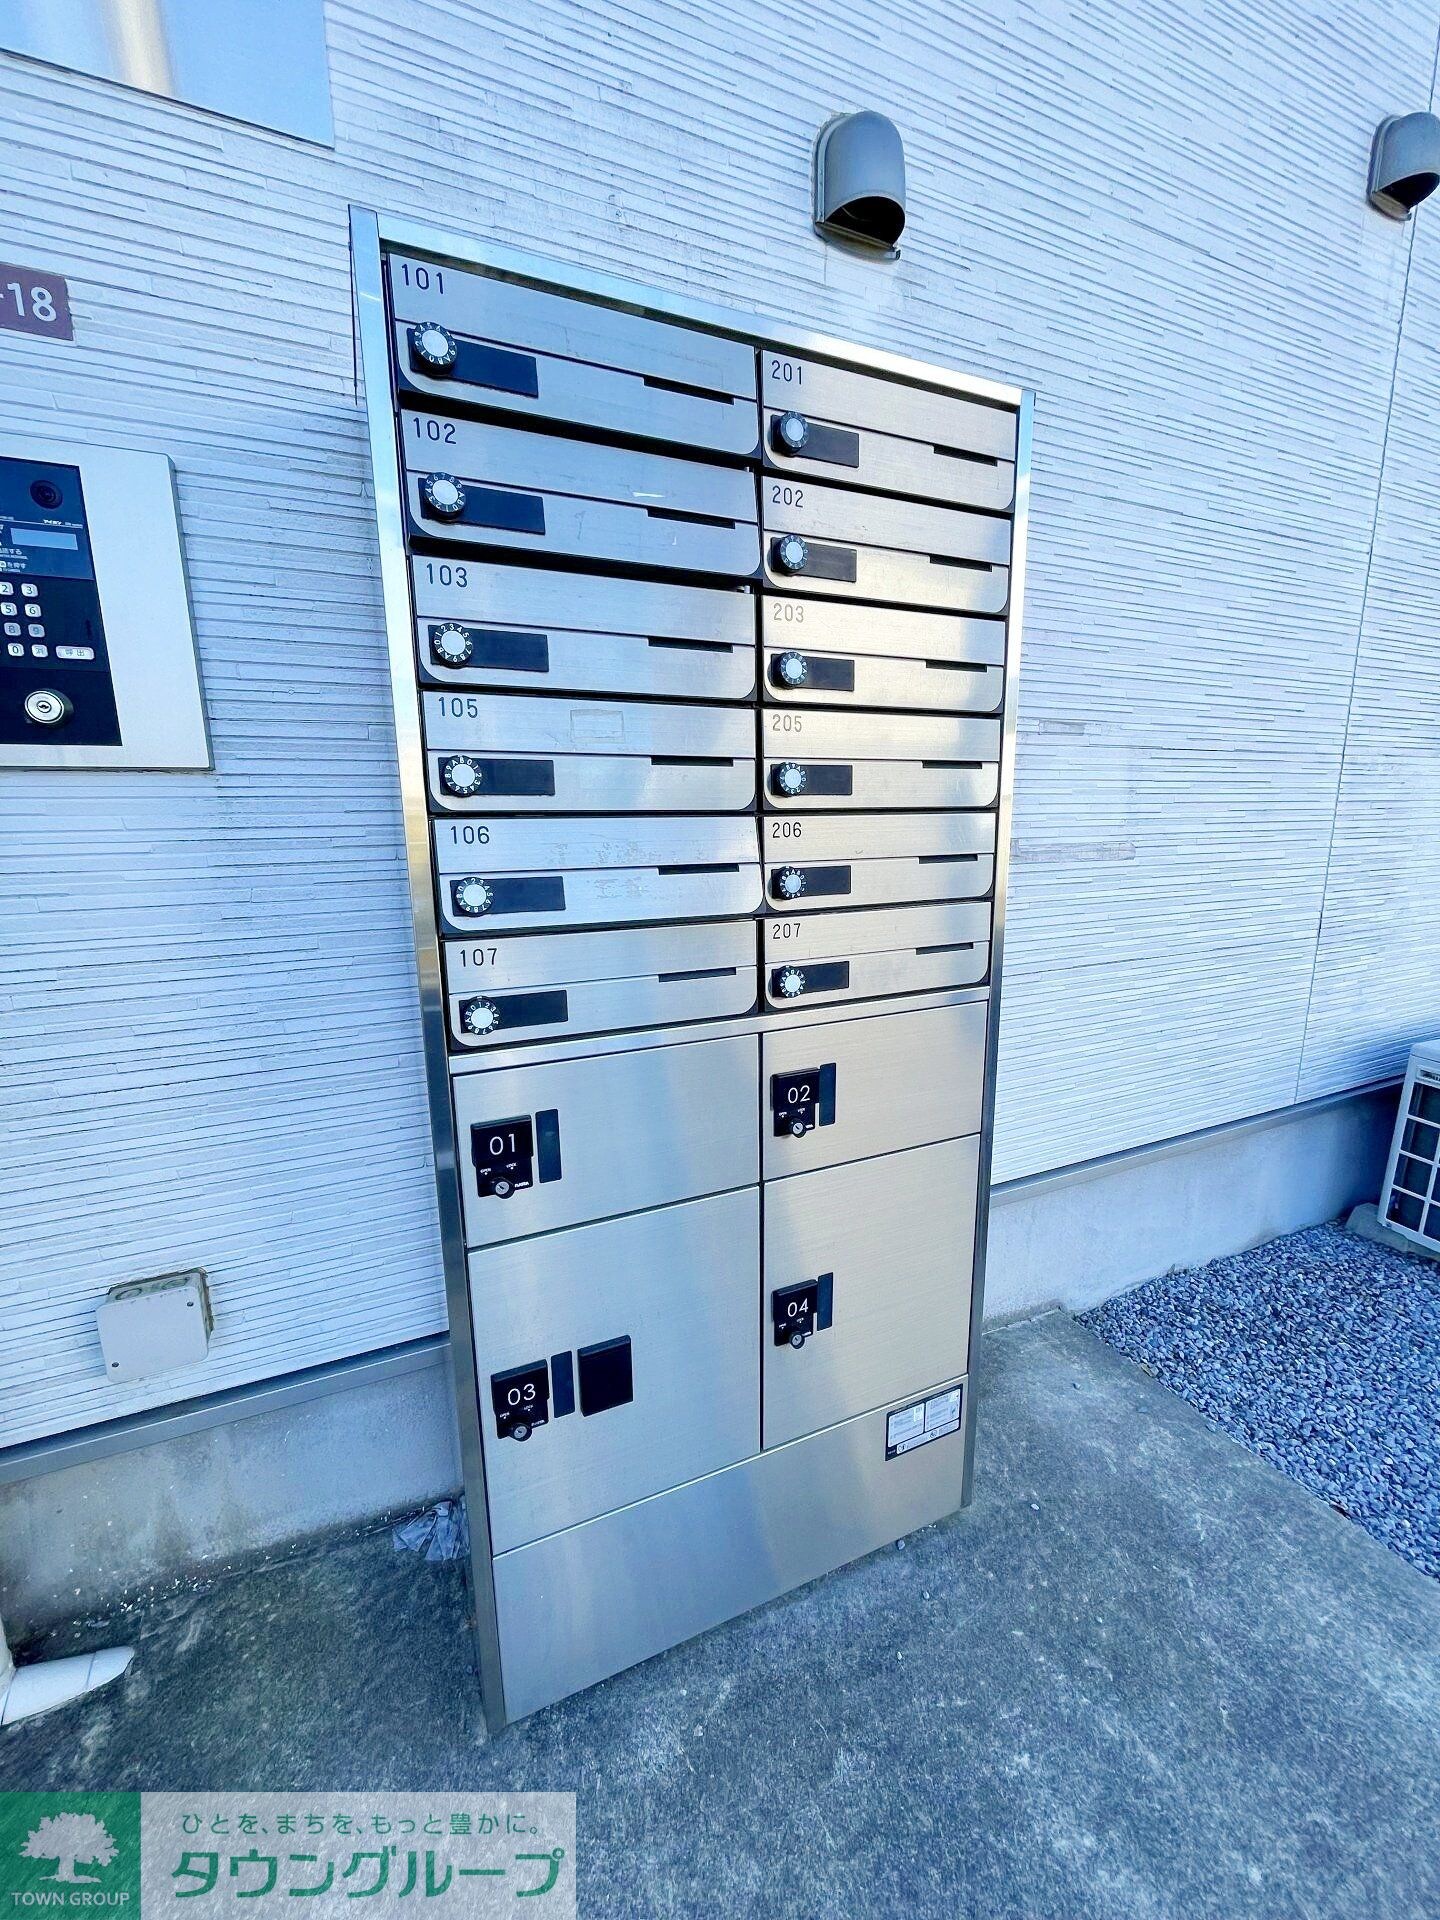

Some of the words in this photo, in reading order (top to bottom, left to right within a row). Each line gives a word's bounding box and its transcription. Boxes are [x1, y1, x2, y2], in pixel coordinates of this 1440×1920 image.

[401, 263, 444, 294] 101
[771, 359, 803, 385] 201
[413, 417, 457, 444] 102
[772, 485, 804, 508] 202
[426, 563, 468, 588] 103
[1, 584, 9, 593] 2
[26, 586, 34, 595] 3
[5, 604, 13, 614] 5
[28, 606, 37, 615] 6
[772, 602, 804, 624] 203
[32, 627, 40, 635] 9
[12, 645, 19, 654] 0
[437, 696, 479, 719] 105
[772, 714, 803, 733] 205
[450, 825, 490, 845] 106
[772, 821, 802, 839] 206
[772, 922, 802, 940] 207
[459, 947, 499, 968] 107
[787, 1084, 811, 1104] 02
[489, 1133, 516, 1156] 01
[787, 1297, 809, 1317] 04
[507, 1383, 536, 1406] 03
